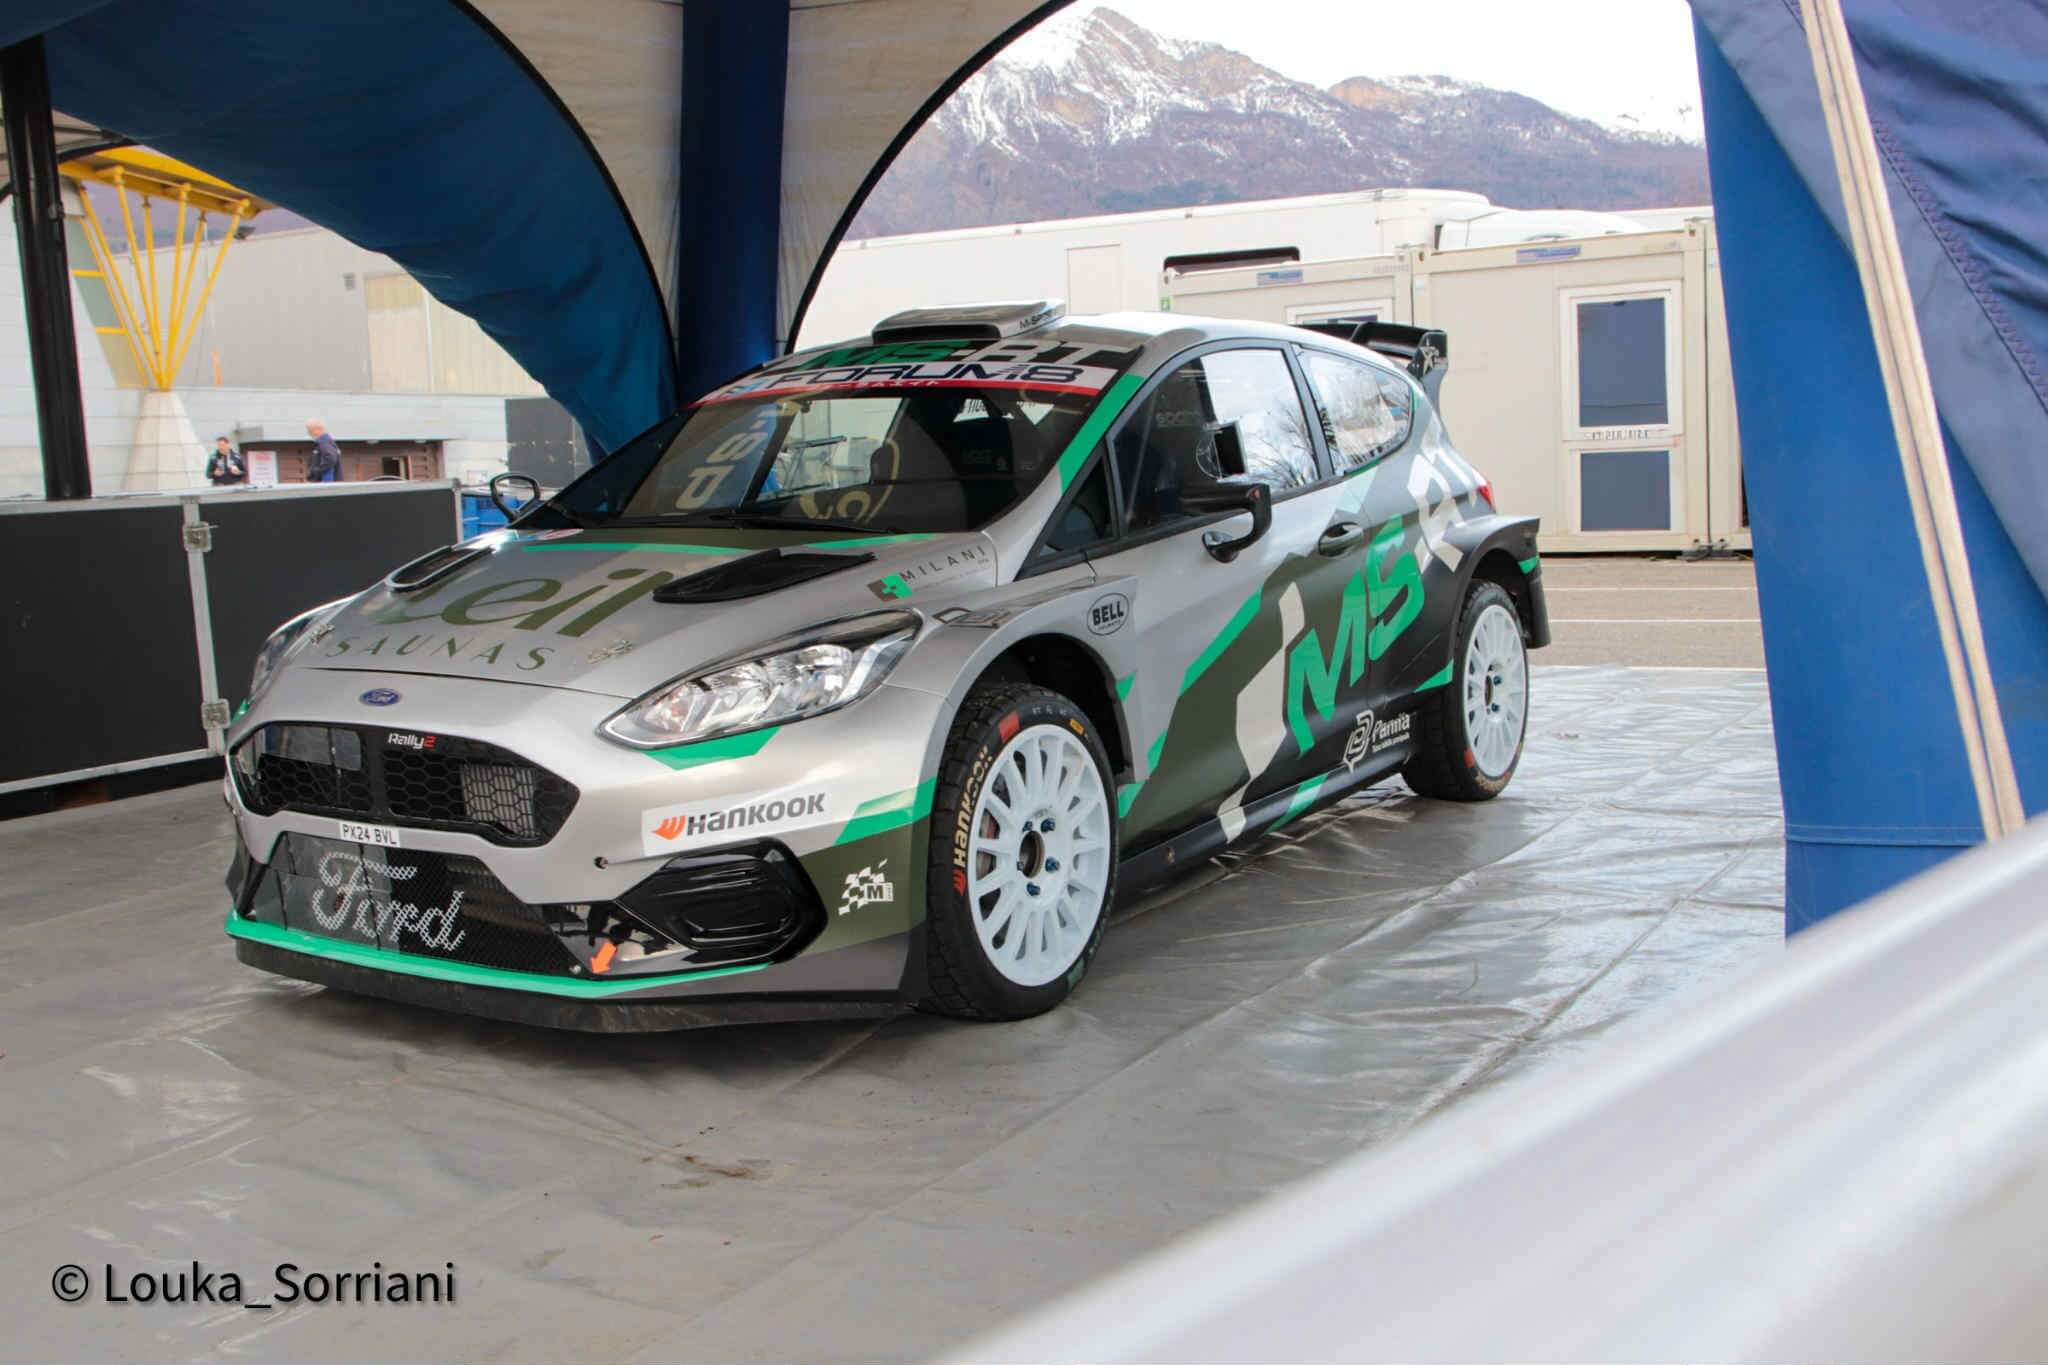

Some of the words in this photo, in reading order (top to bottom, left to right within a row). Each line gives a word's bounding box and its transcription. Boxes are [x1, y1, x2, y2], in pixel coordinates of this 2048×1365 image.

[767, 363, 1084, 389] FORUM8
[899, 545, 986, 582] MILANI
[1092, 600, 1124, 626] BELL
[324, 633, 554, 671] SAUNAS
[388, 732, 437, 750] Rally2
[342, 823, 371, 840] PX24
[374, 829, 398, 845] BVL
[312, 851, 466, 951] Ford
